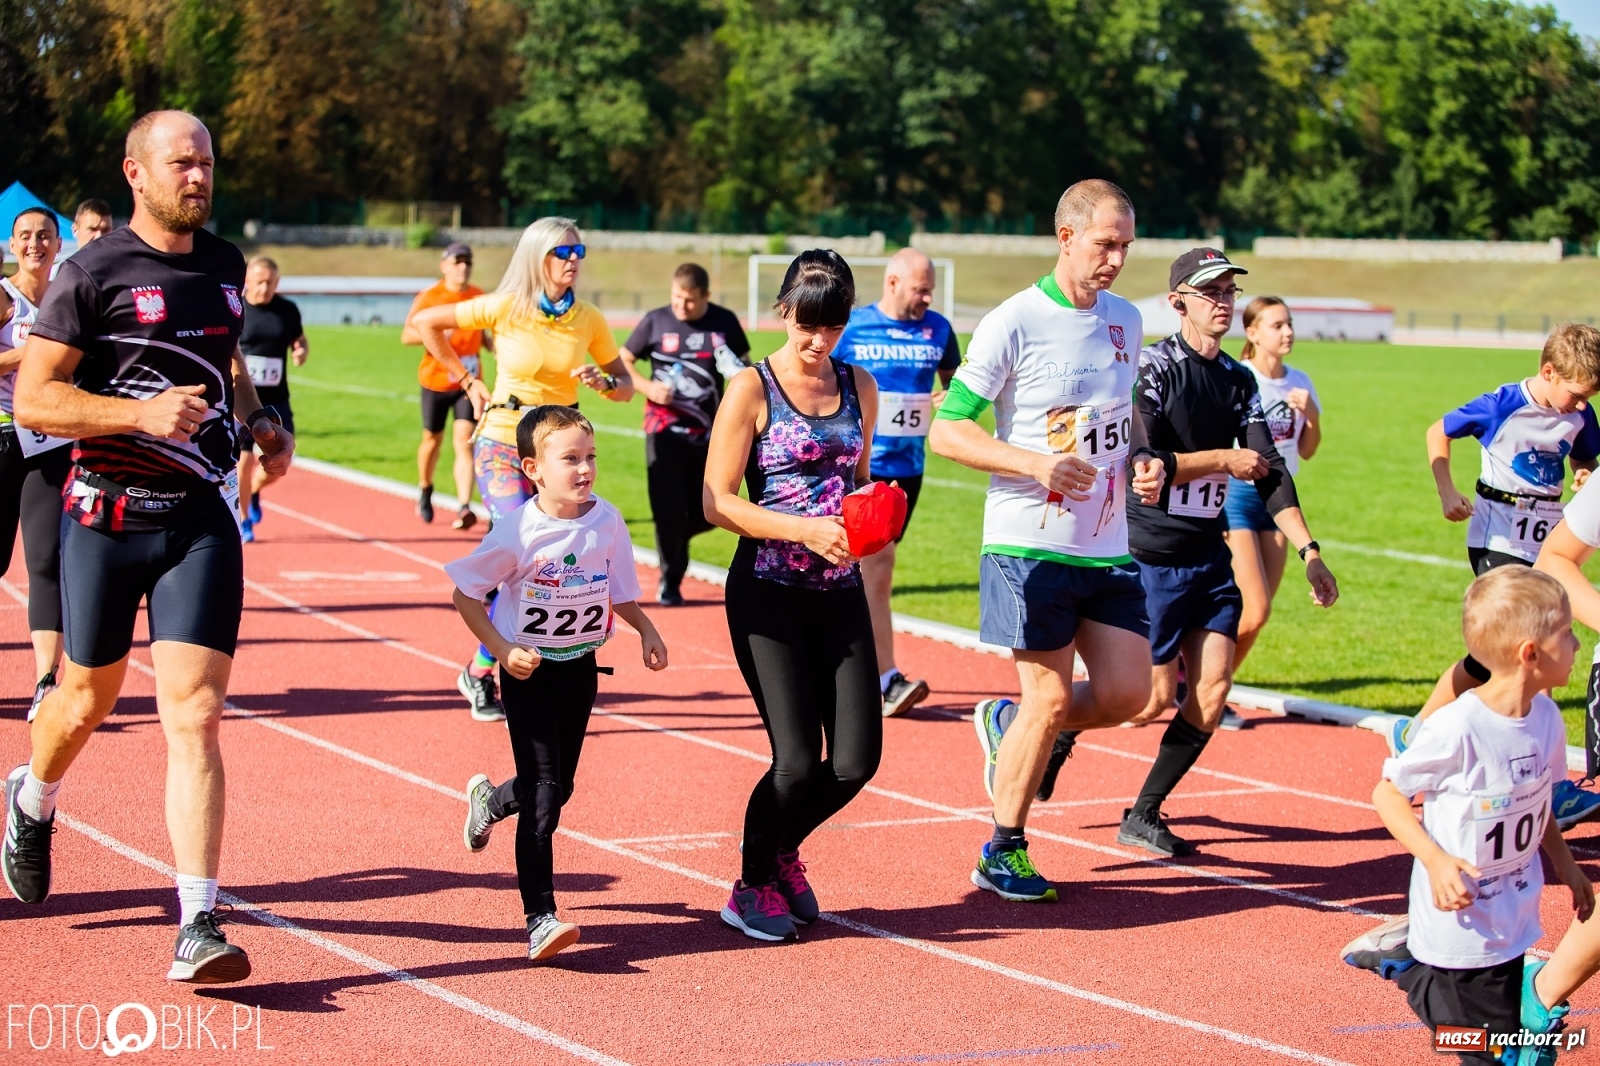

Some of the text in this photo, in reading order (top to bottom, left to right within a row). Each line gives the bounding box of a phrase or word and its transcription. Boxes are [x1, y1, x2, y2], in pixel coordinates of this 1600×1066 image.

[131, 285, 162, 294] POLSKA
[853, 343, 944, 361] RUNNERS
[891, 409, 922, 428] 45
[1083, 416, 1131, 456] 150
[152, 490, 187, 499] Kalenji
[1176, 481, 1227, 509] 115
[1516, 516, 1561, 544] 16
[522, 604, 604, 637] 222
[1484, 799, 1547, 861] 101
